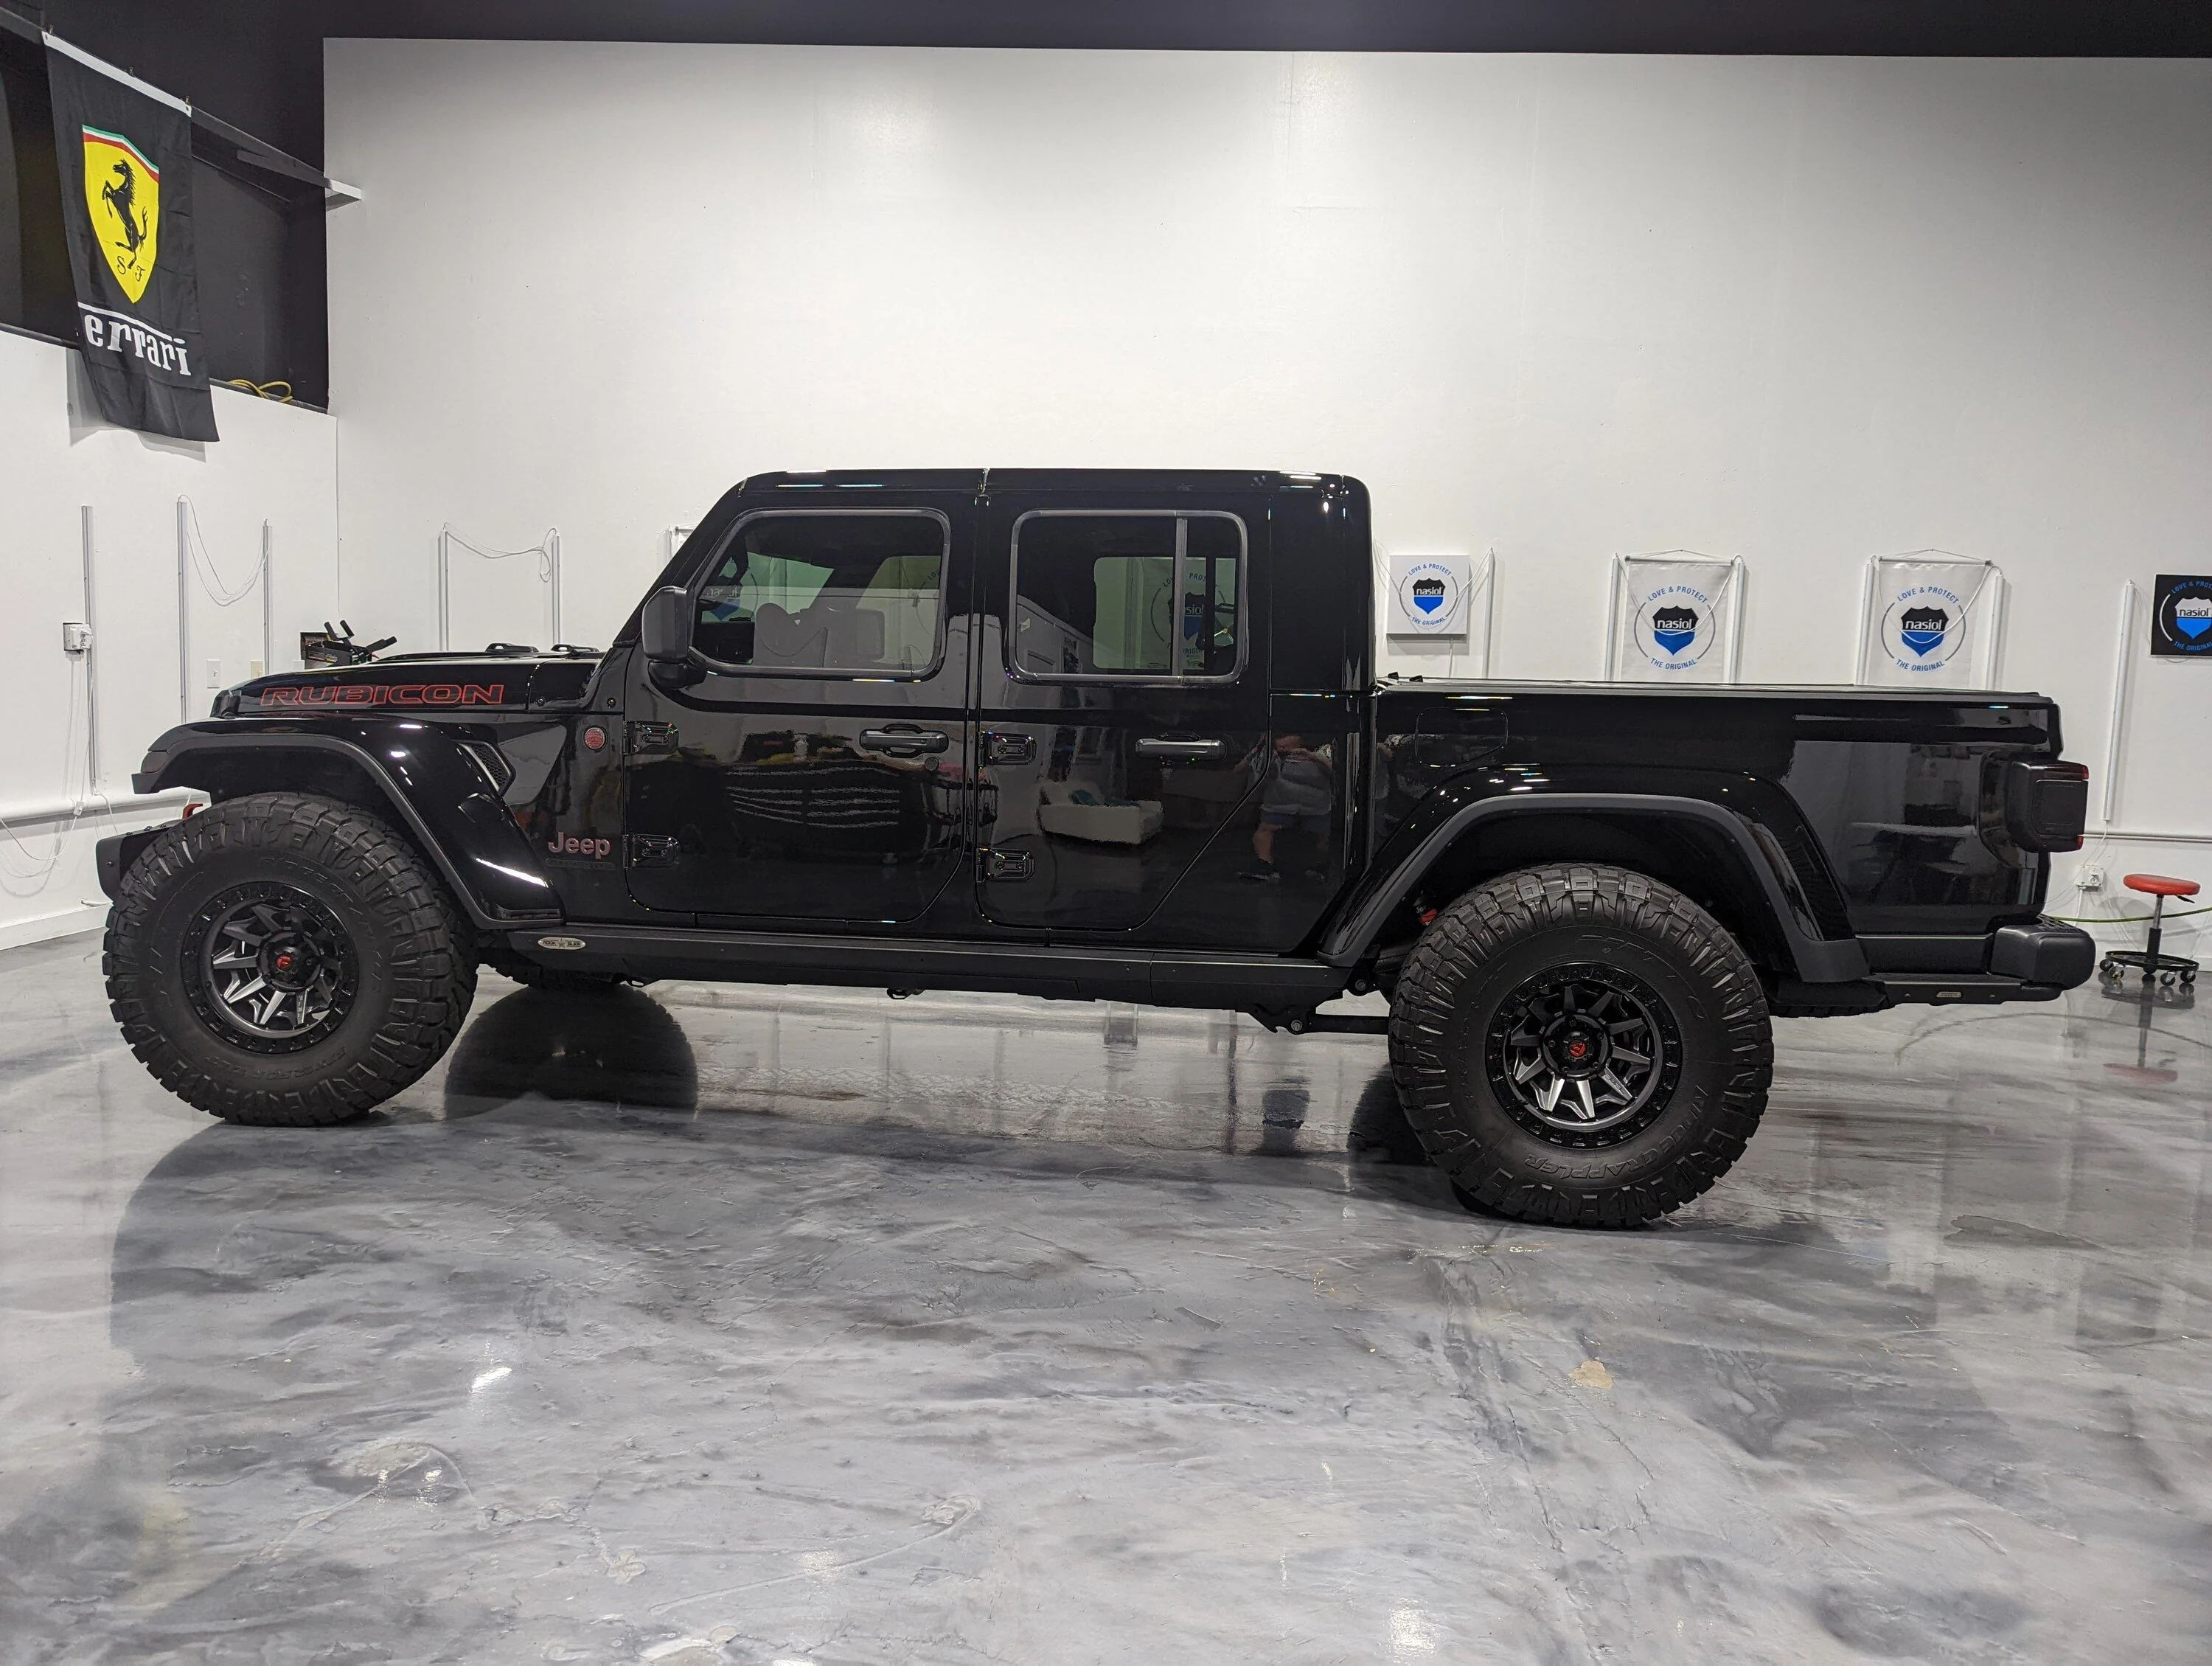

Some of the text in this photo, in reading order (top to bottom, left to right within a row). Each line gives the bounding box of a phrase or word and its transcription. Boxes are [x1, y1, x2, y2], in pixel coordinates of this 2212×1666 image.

[927, 569, 940, 580] LOV
[1408, 564, 1421, 576] LOVE
[1428, 563, 1452, 575] PROTECT
[1416, 586, 1442, 595] nasiol
[2171, 582, 2188, 594] LOVE
[1647, 588, 1666, 601] LOVE
[1677, 586, 1708, 603] PROTECT
[1896, 588, 1917, 602] LOVE
[1927, 586, 1959, 604] PROTECT
[1184, 604, 1204, 615] siol
[2179, 608, 2209, 617] nasiol
[1422, 617, 1446, 625] ORIGINAL
[1657, 618, 1692, 629] nasiol
[1905, 619, 1942, 631] nasiol
[2173, 640, 2185, 650] THE
[1650, 658, 1697, 670] THE ORIGINAL
[1896, 659, 1945, 672] THE ORIGINAL
[260, 684, 504, 706] RUBICON
[548, 831, 611, 860] Jeep
[1524, 1148, 1658, 1179] GRAPPLER
